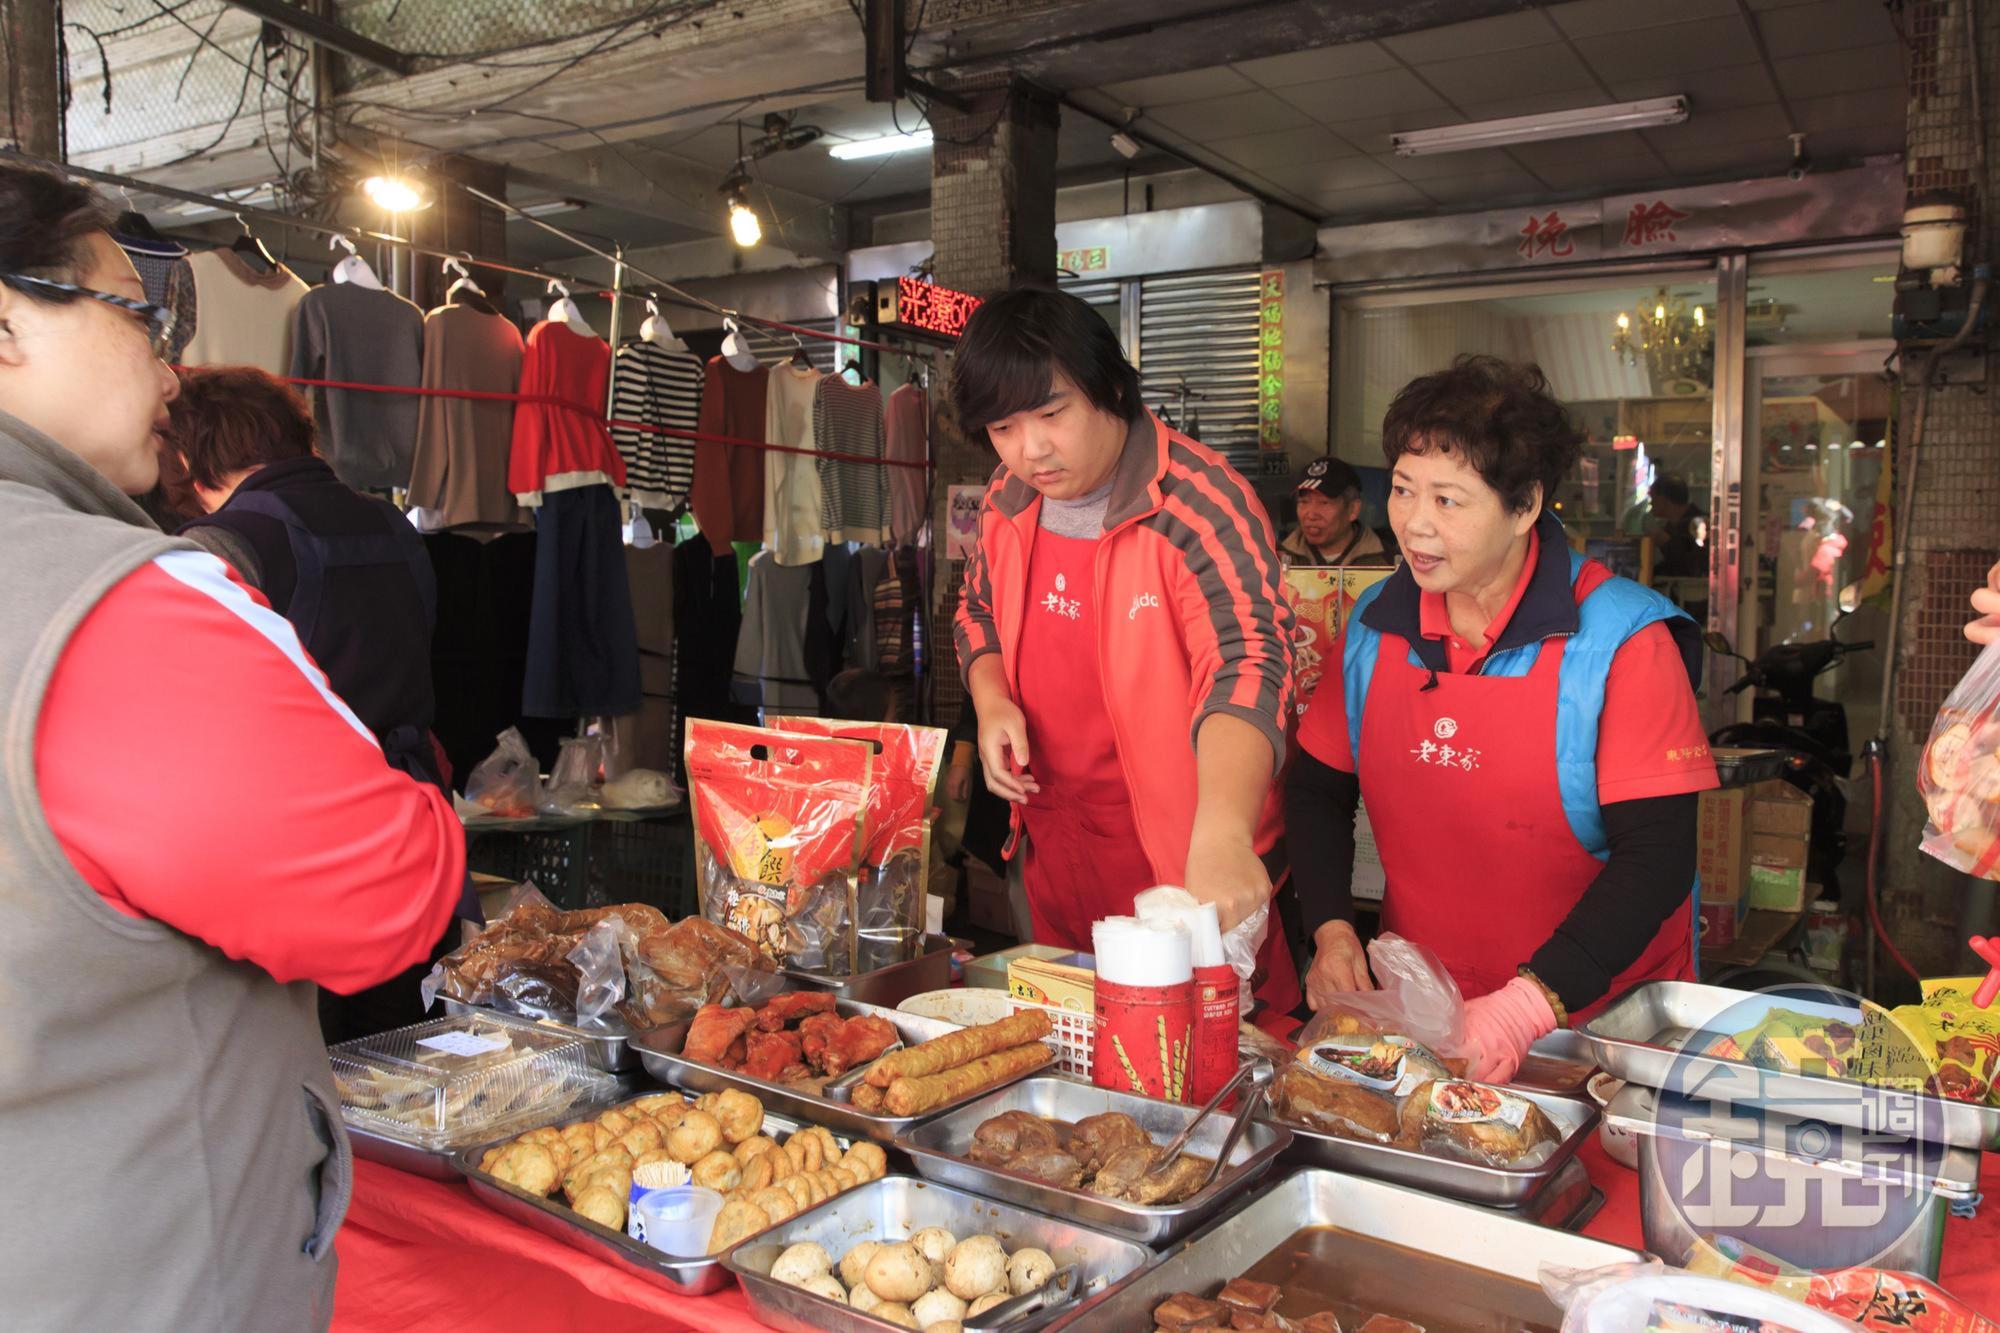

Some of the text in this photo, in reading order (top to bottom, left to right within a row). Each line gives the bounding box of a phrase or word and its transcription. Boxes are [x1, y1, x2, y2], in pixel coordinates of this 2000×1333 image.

[1519, 201, 1688, 258] 挽臉
[1040, 592, 1081, 620] 老東家
[1410, 739, 1483, 771] 老東家
